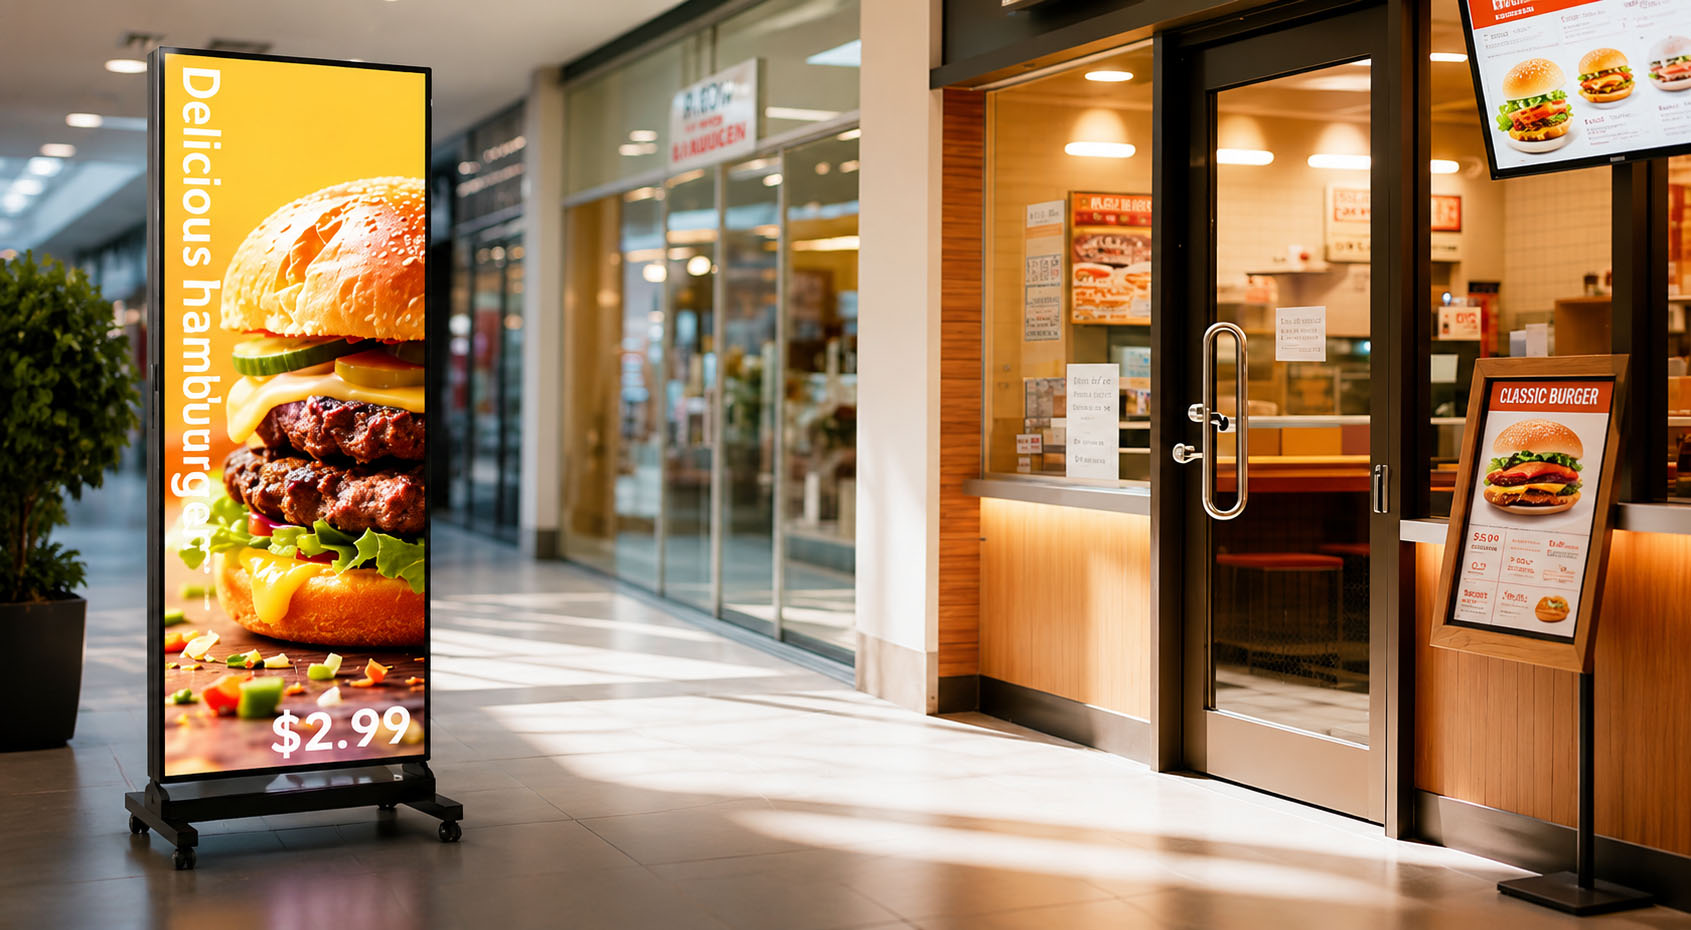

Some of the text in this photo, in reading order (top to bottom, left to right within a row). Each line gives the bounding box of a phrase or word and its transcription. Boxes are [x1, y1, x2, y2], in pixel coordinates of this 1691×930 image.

[182, 66, 222, 267] Delicious
[1499, 387, 1599, 405] CLASSIC BURGER
[271, 705, 411, 759] $2.99
